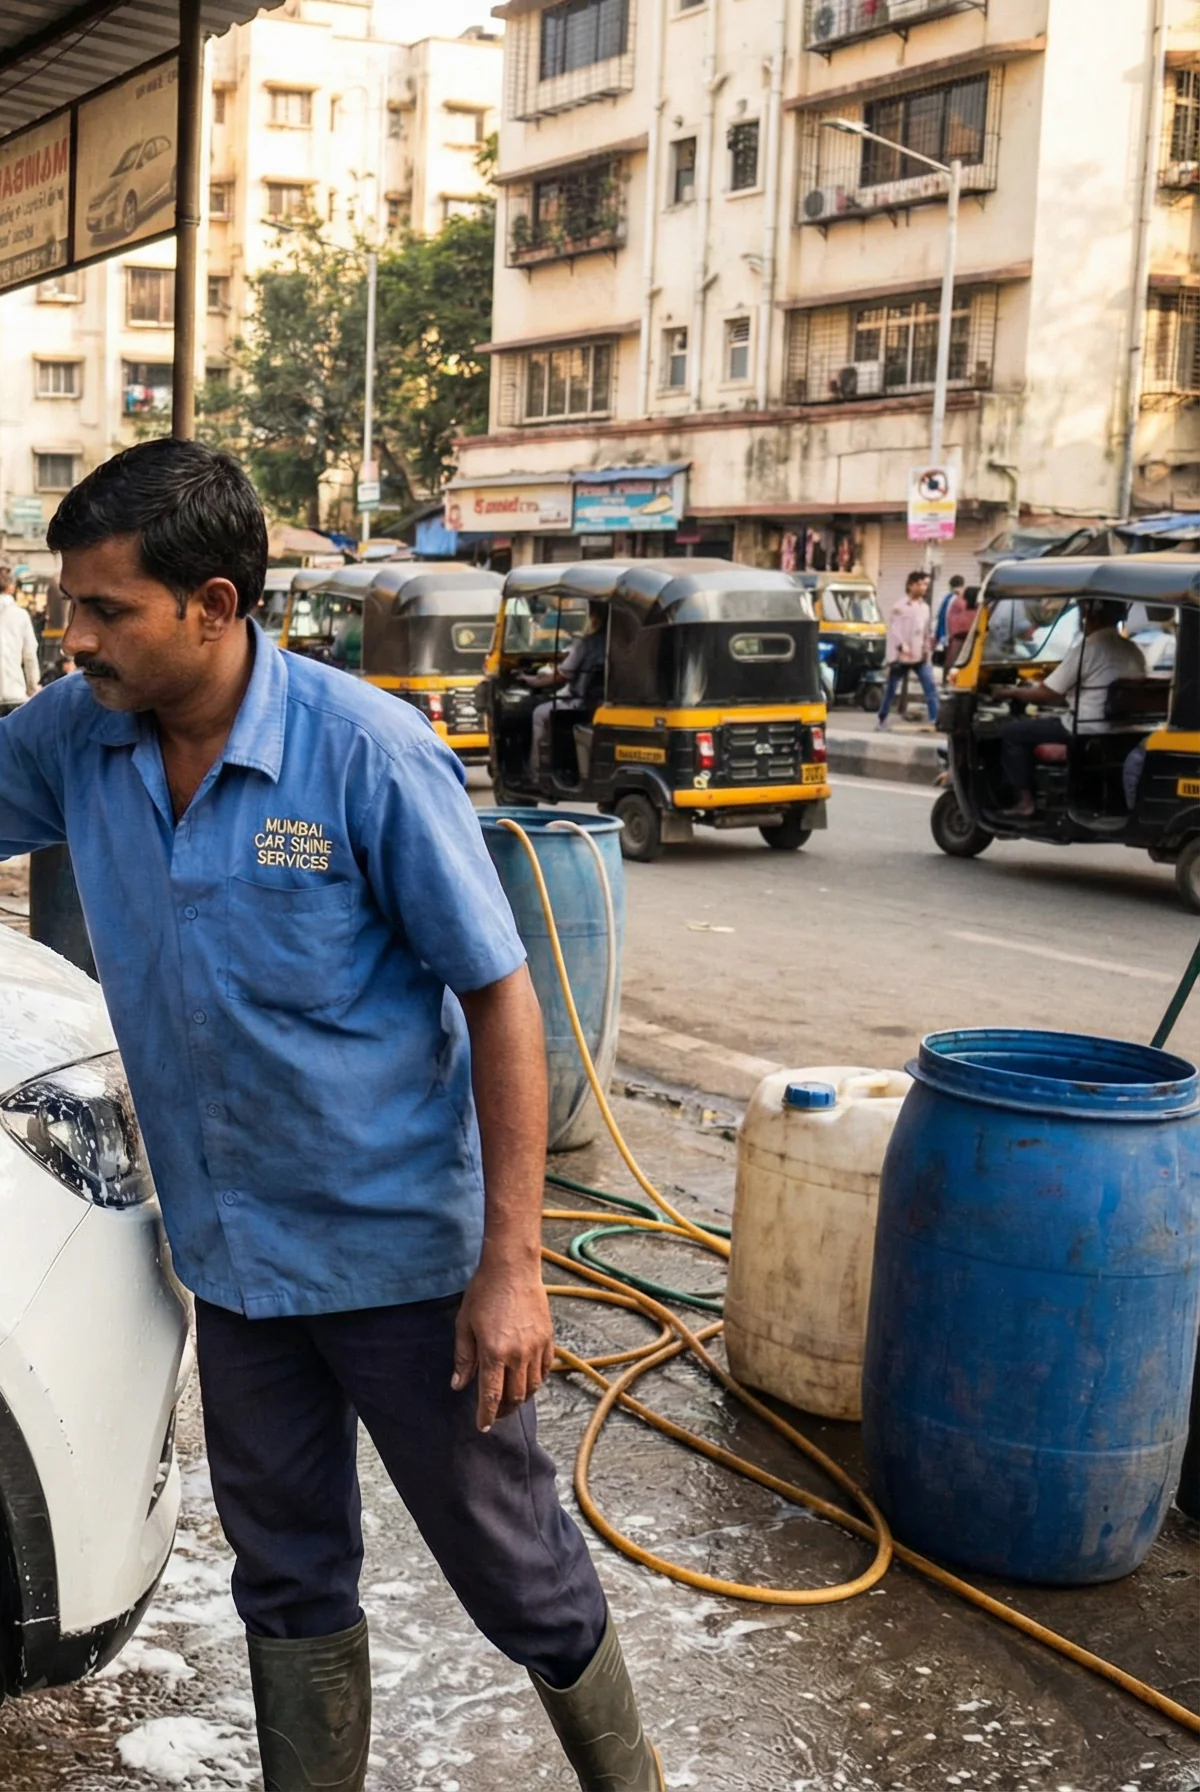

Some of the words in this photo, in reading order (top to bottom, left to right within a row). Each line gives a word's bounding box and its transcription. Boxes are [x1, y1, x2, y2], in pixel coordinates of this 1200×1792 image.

[266, 818, 323, 837] MUMBAI
[254, 833, 286, 849] CAR
[290, 836, 333, 854] SHINE
[257, 849, 329, 870] SERVICES
